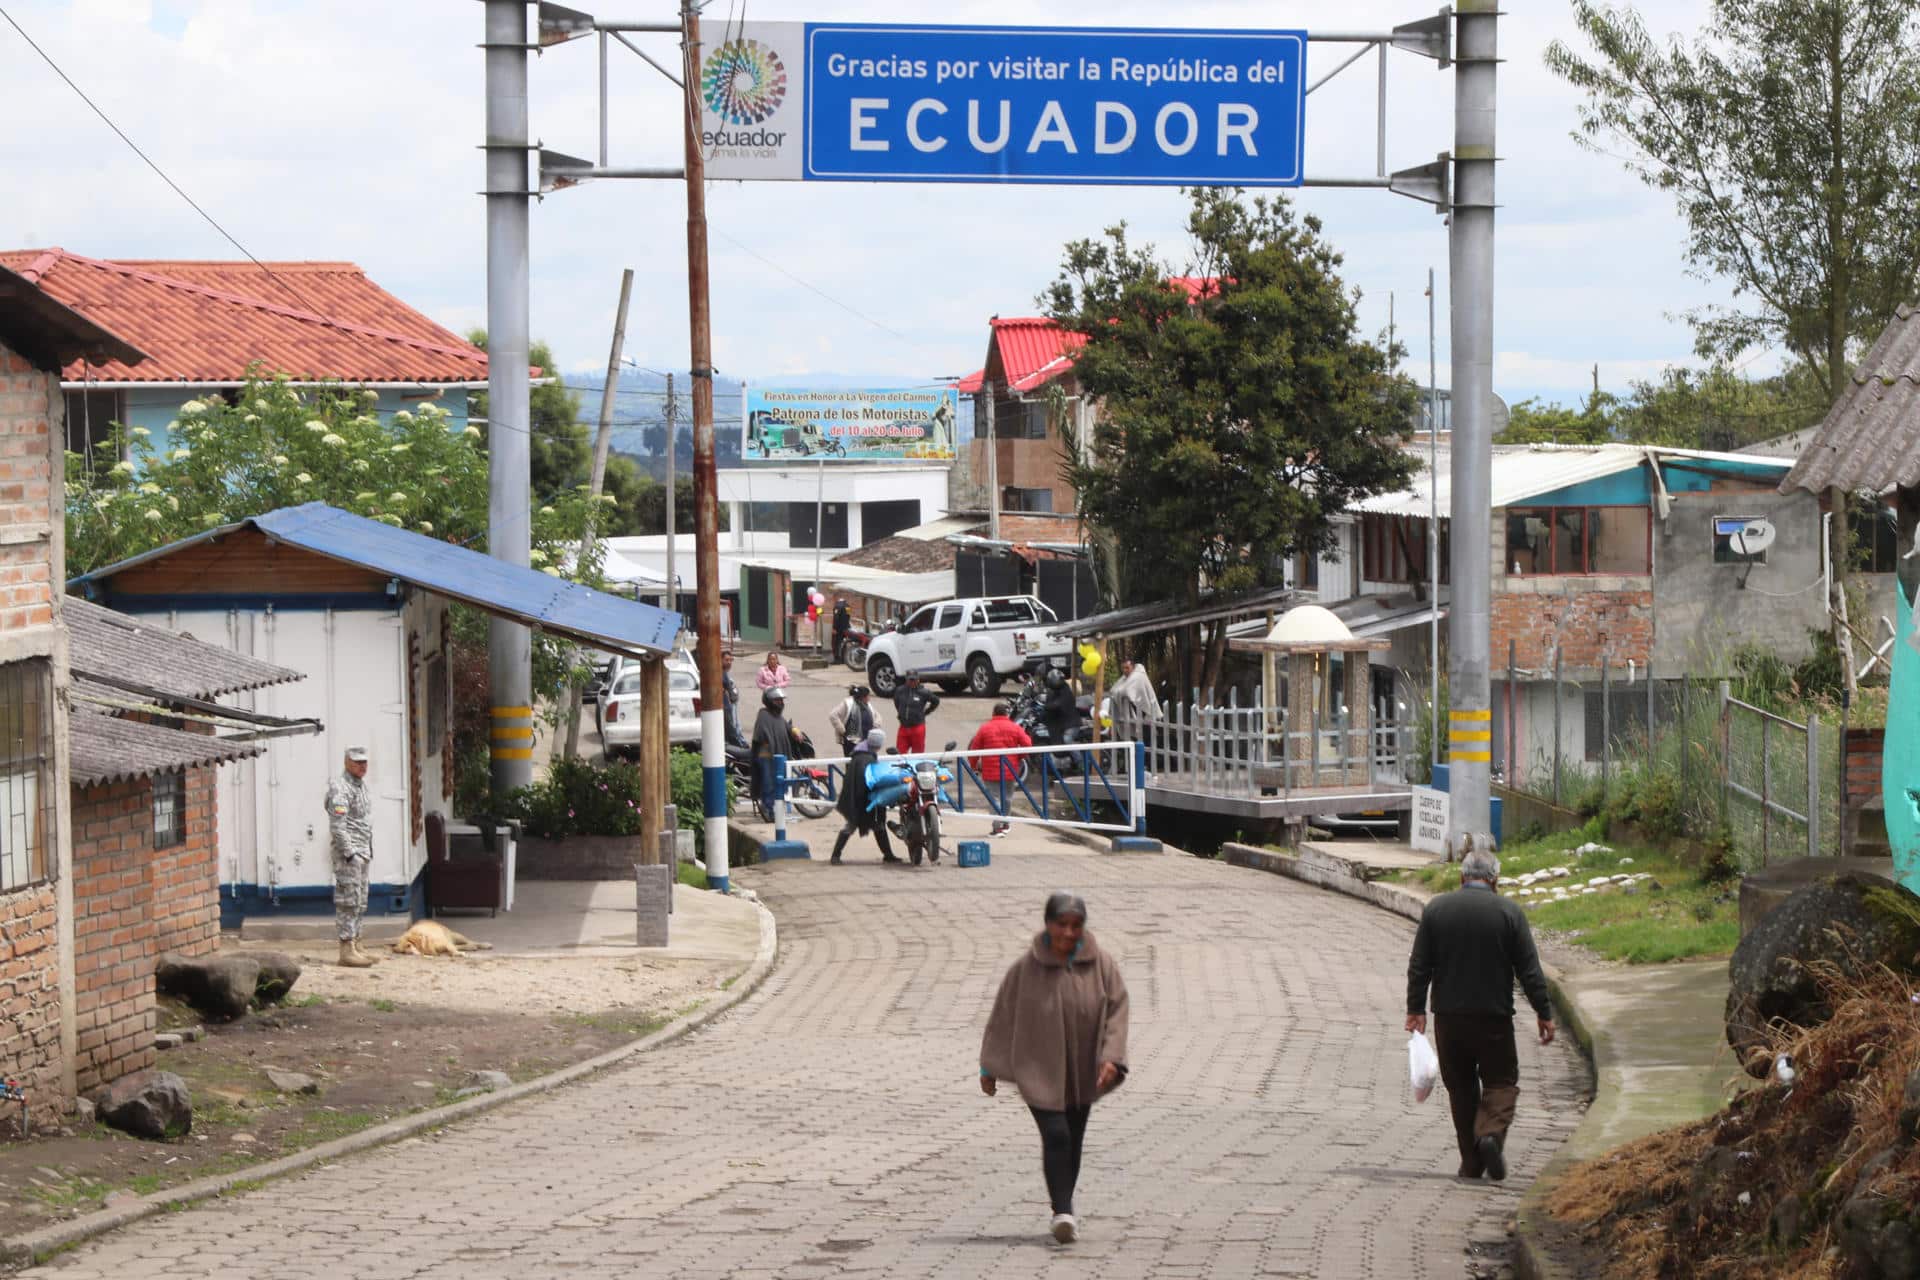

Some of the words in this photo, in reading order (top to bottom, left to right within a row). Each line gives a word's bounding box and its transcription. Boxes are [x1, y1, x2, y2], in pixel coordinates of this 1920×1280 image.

[828, 53, 928, 78] Gracias
[937, 61, 980, 83] por
[988, 55, 1070, 80] visitar
[1079, 57, 1101, 80] la
[1111, 57, 1238, 87] República
[1247, 60, 1284, 83] del
[850, 98, 1259, 156] ECUADOR
[702, 128, 786, 147] ecuador
[764, 392, 797, 402] Fiestas
[798, 394, 809, 402] en
[811, 392, 837, 402] Honor
[846, 392, 856, 402] La
[858, 392, 885, 404] Virgen
[887, 392, 901, 402] del
[903, 392, 937, 402] Carmen
[772, 407, 820, 420] Patrona
[824, 408, 838, 421] de
[841, 408, 859, 421] los
[862, 407, 928, 421] Motoristas
[829, 426, 845, 436] del
[848, 426, 860, 436] 10
[862, 426, 872, 436] al
[872, 426, 886, 437] 20
[887, 426, 898, 437] de
